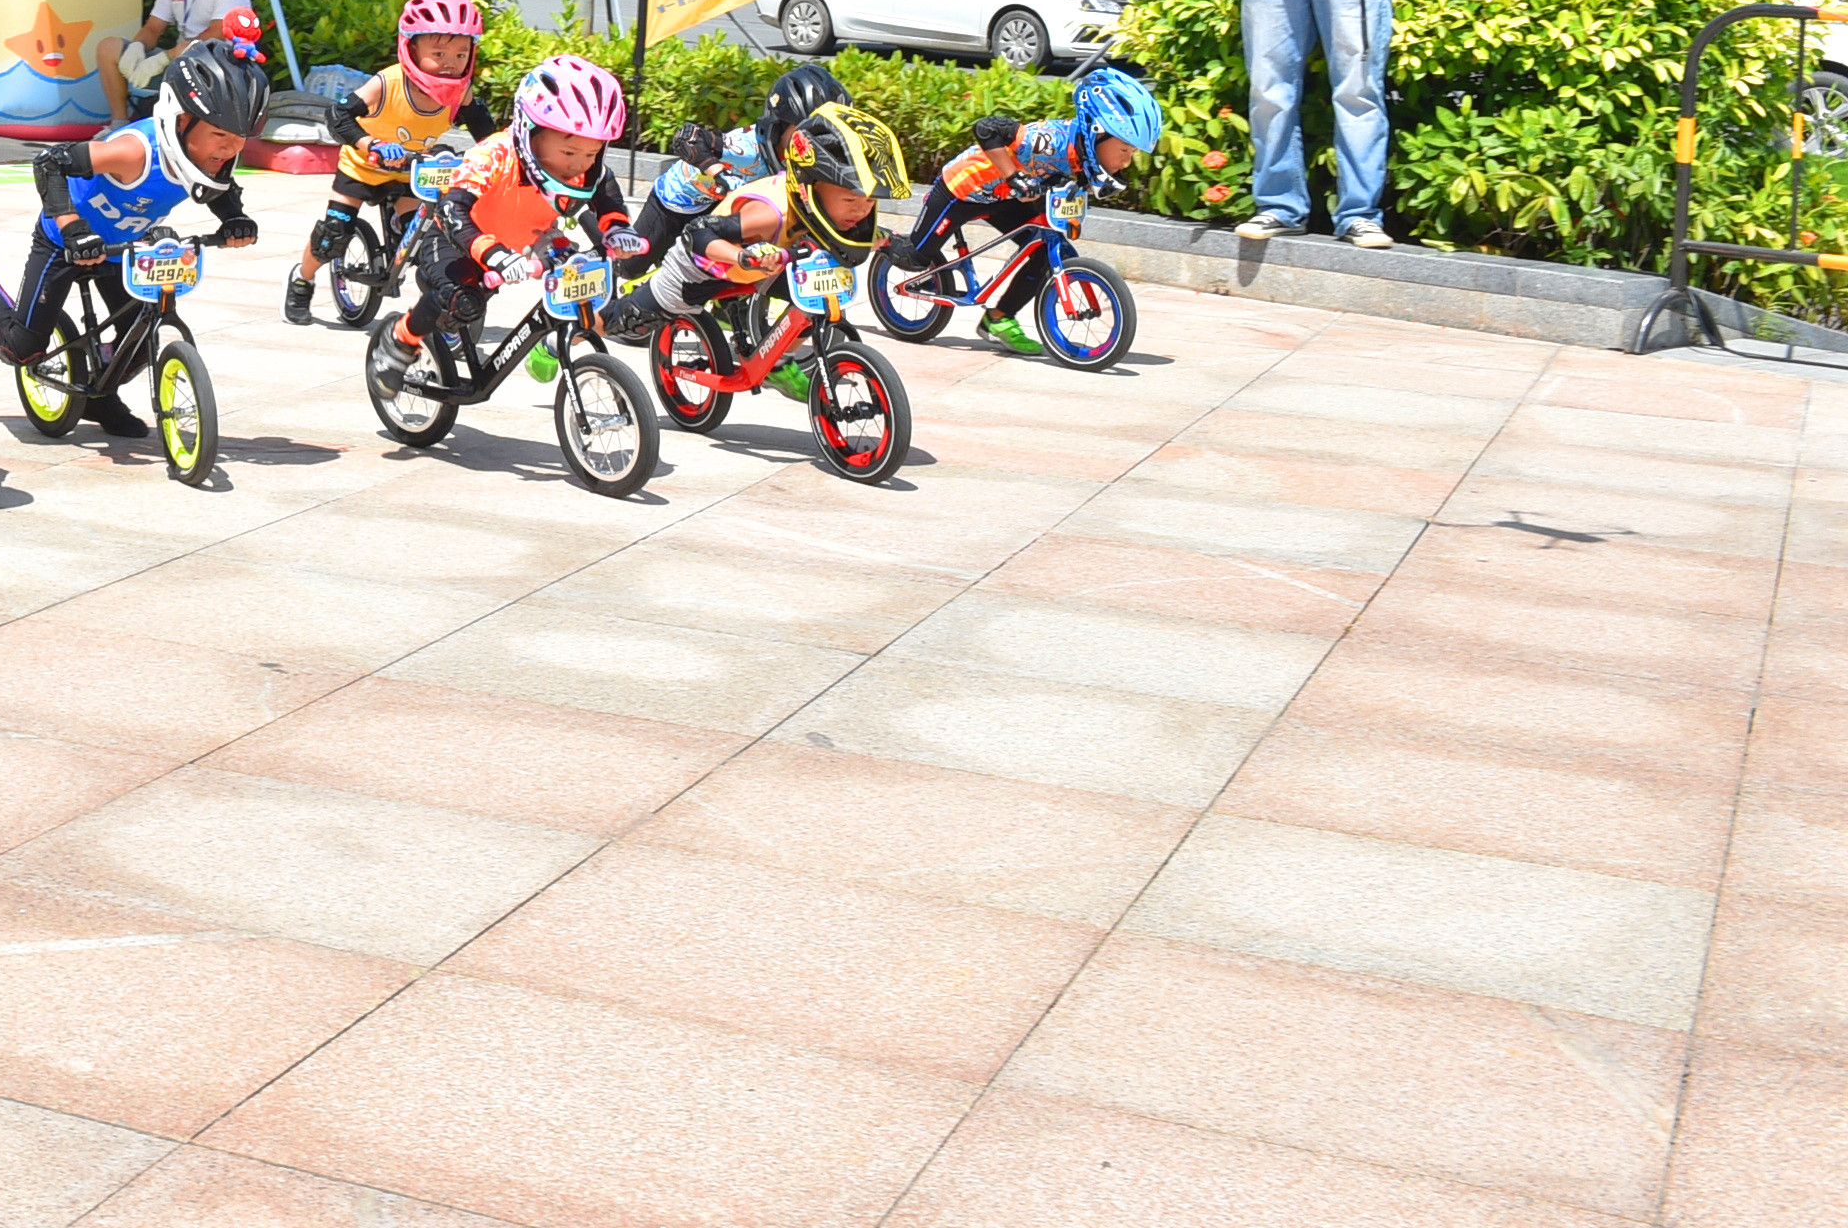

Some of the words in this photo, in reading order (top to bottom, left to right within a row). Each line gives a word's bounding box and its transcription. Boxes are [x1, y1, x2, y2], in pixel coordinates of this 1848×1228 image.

[87, 192, 166, 233] DA
[563, 281, 596, 299] 430A
[813, 278, 839, 292] 411A
[492, 335, 522, 371] PAPA
[758, 326, 783, 360] PAPA
